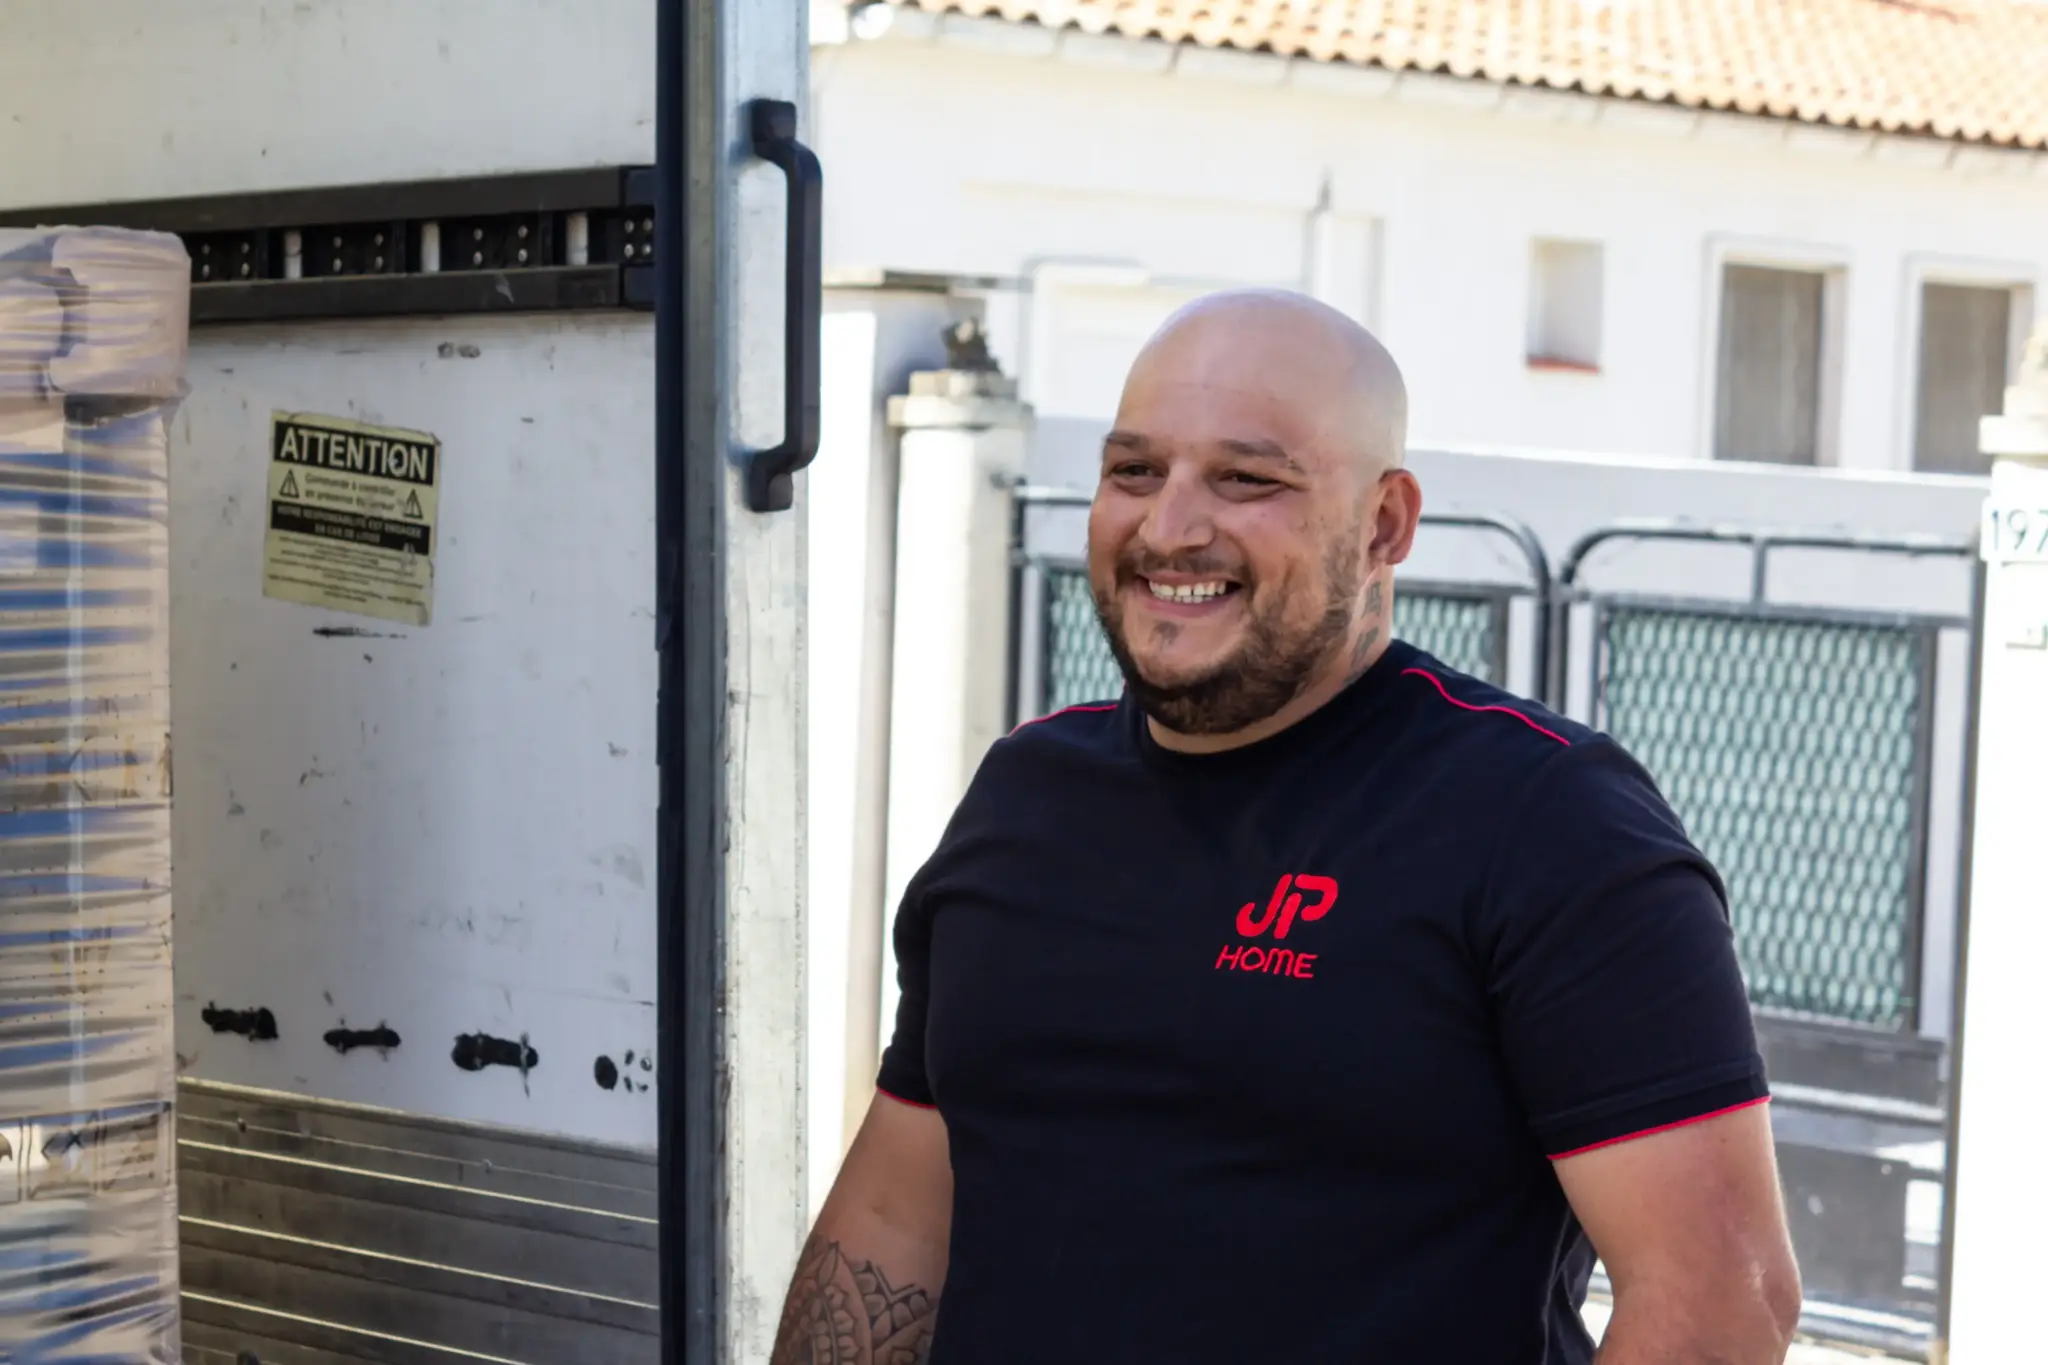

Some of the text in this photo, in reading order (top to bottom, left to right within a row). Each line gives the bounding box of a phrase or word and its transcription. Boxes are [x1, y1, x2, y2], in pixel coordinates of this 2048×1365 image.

[280, 426, 428, 481] ATTENTION
[1235, 873, 1339, 940] JP
[1214, 944, 1319, 979] HOME
